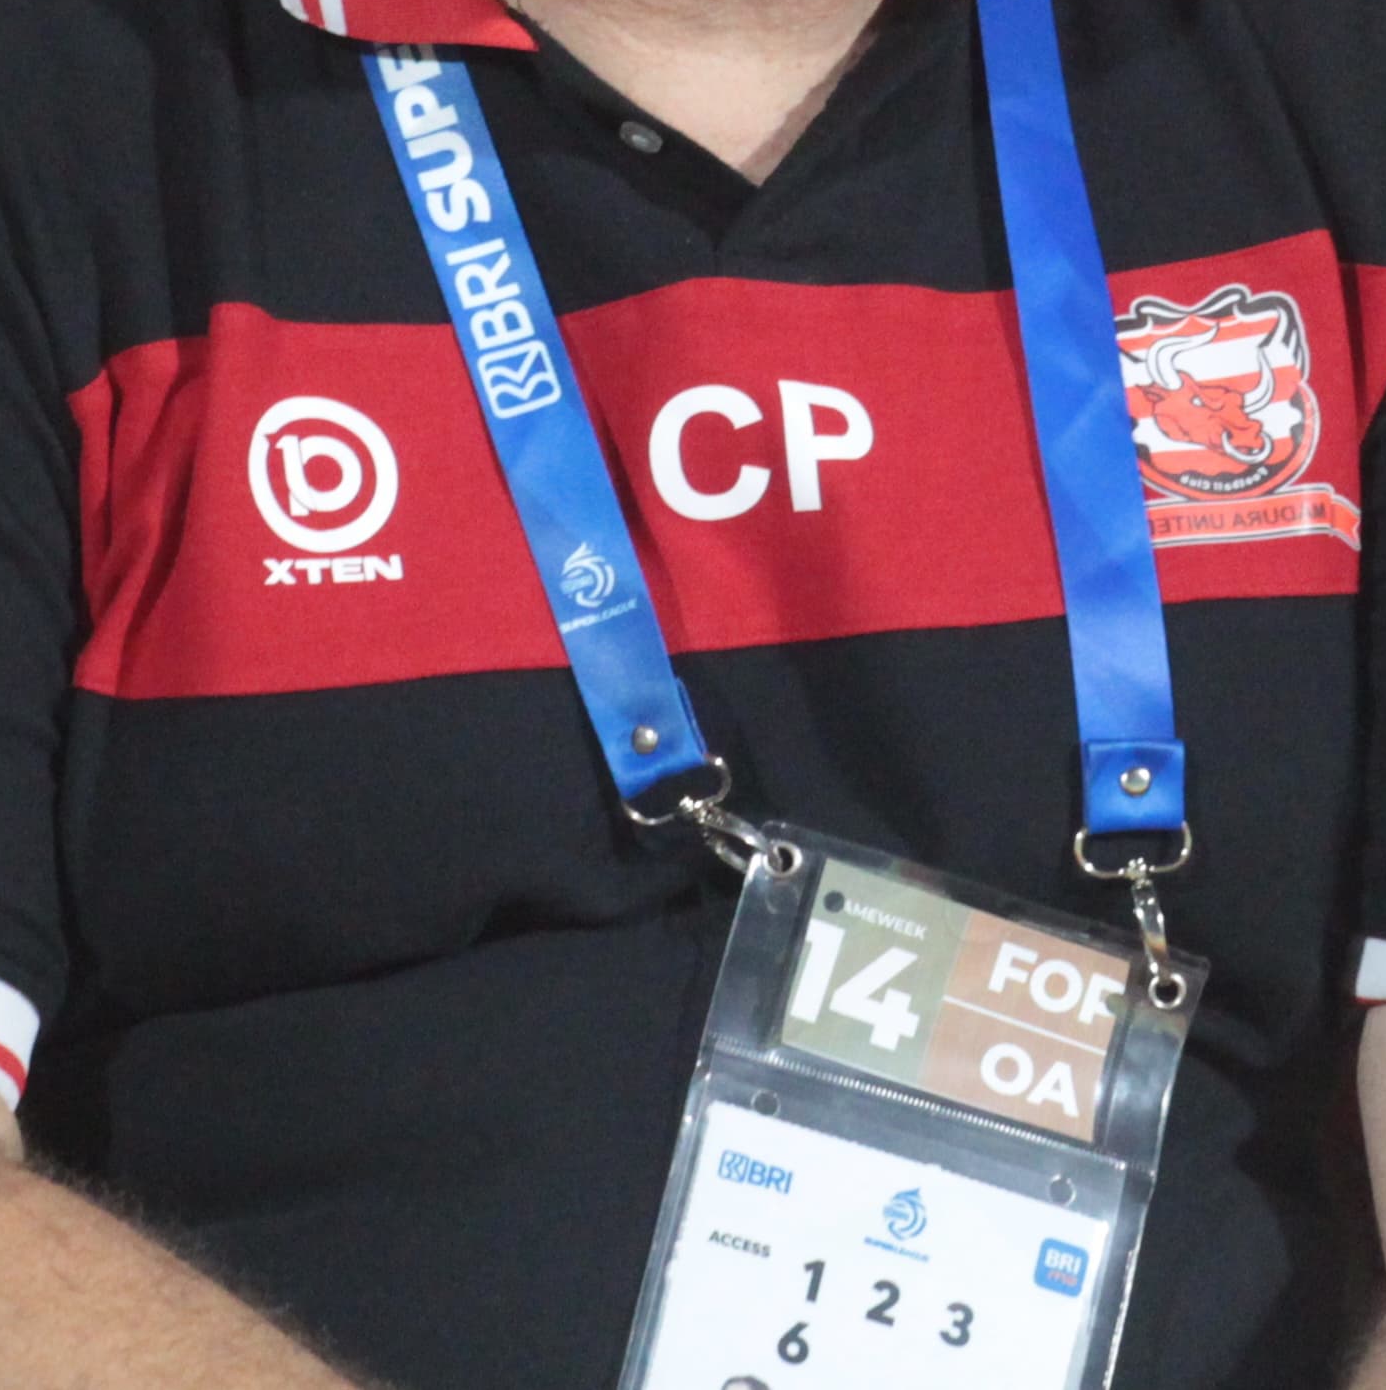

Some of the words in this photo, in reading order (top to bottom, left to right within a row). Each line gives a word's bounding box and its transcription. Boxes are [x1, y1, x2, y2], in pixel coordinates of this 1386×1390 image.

[445, 238, 536, 351] BRI
[648, 379, 874, 521] CP
[263, 554, 403, 586] XTEN
[788, 918, 921, 1051] 14
[980, 1042, 1080, 1118] OA
[747, 1159, 794, 1195] BRI
[708, 1229, 772, 1259] ACCESS
[1044, 1247, 1083, 1275] BRI
[803, 1260, 826, 1304] 1
[865, 1279, 901, 1328] 2
[939, 1301, 974, 1348] 3
[776, 1321, 810, 1366] 6
